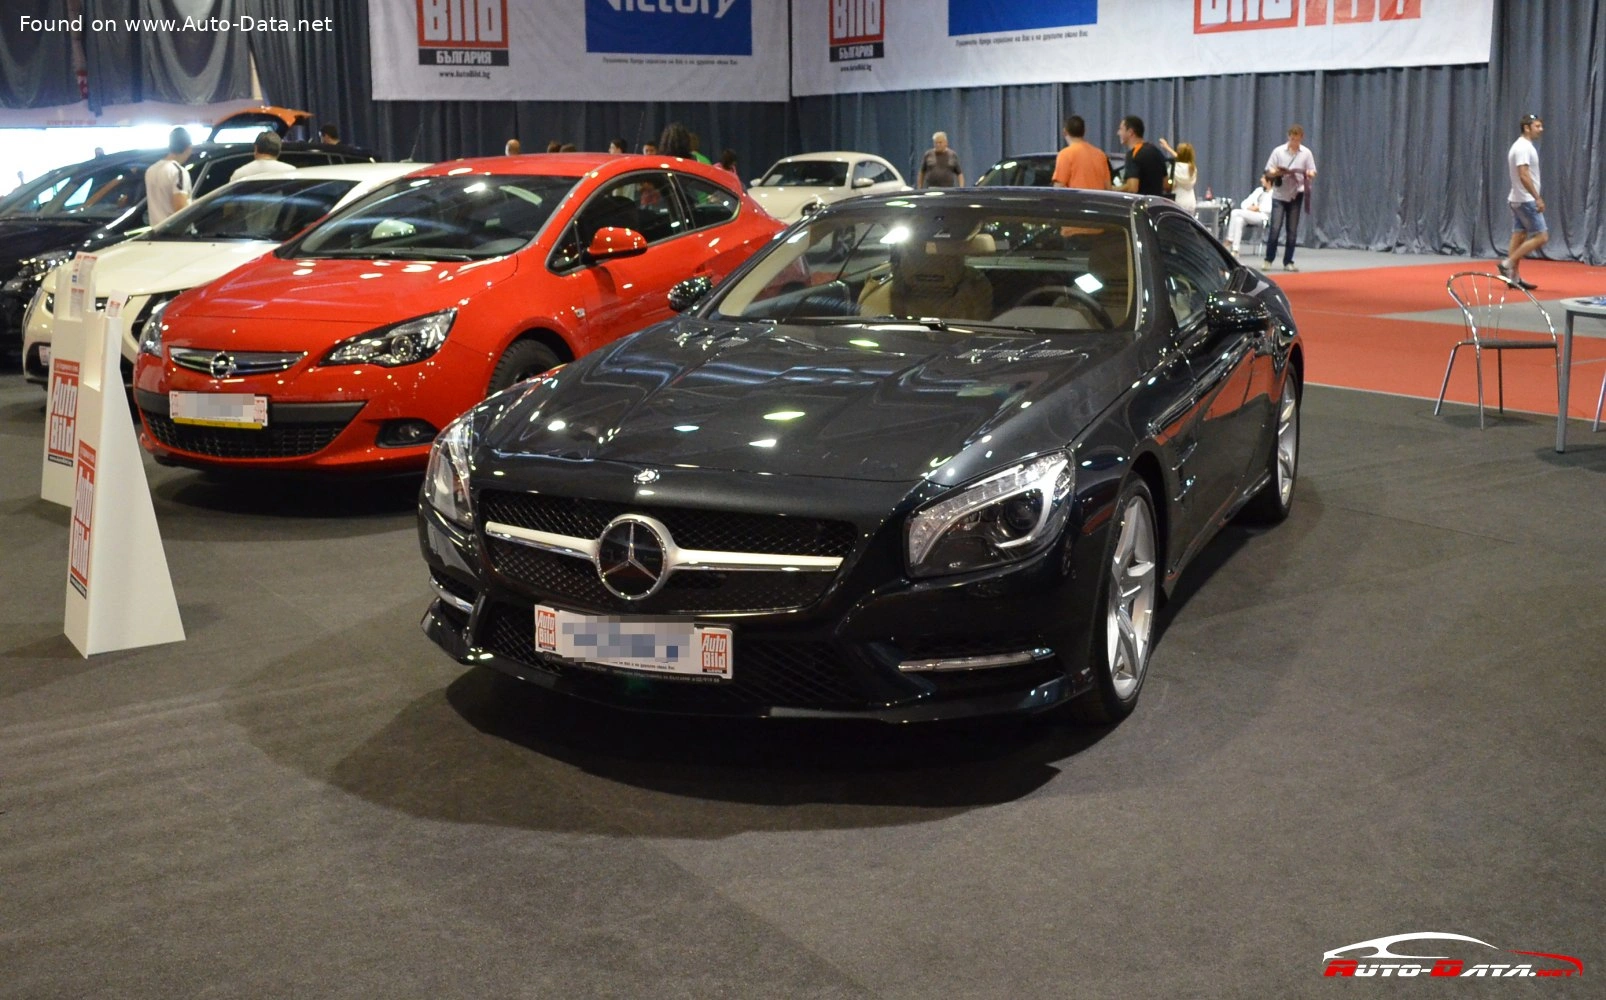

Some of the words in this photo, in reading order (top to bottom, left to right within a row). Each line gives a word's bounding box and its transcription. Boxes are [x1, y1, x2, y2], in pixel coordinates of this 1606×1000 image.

[51, 375, 78, 419] Auto
[703, 634, 726, 652] Auto
[703, 651, 726, 668] Bild
